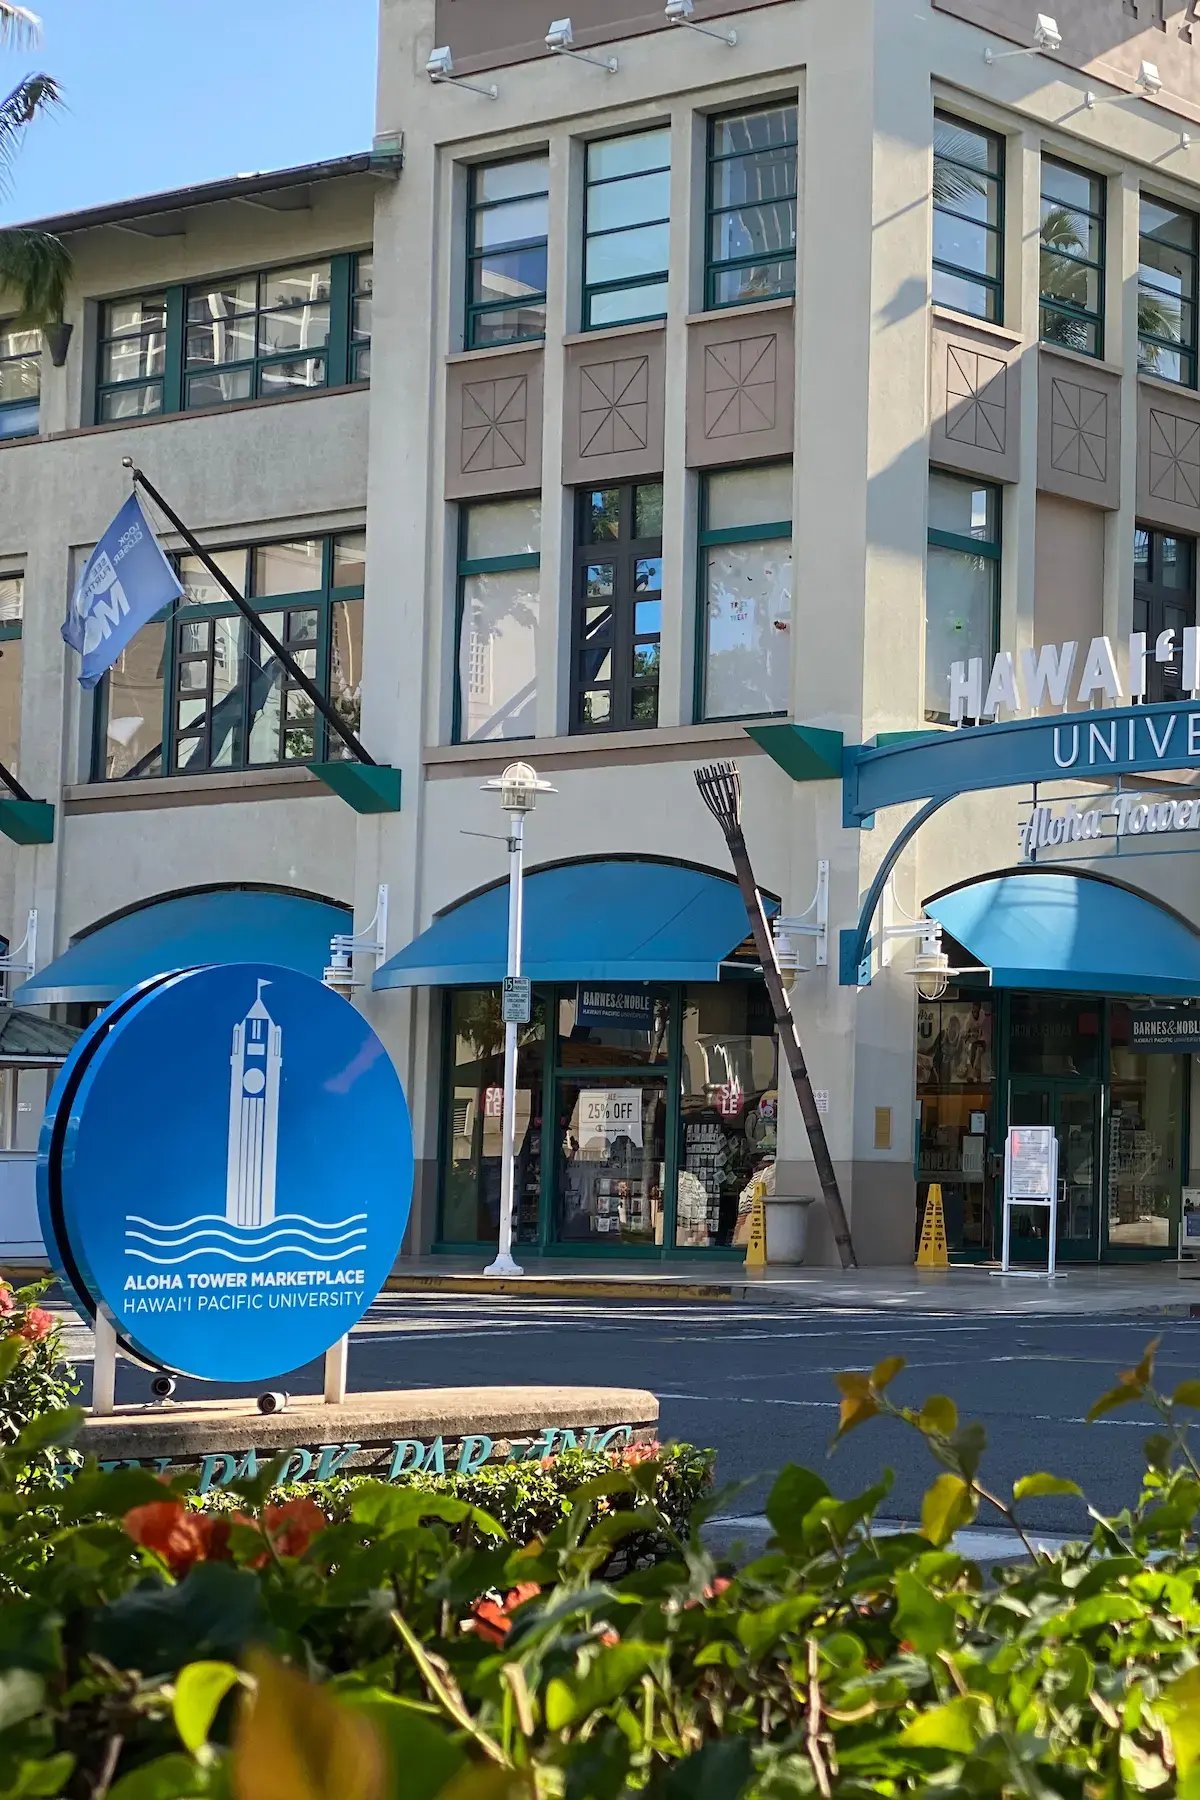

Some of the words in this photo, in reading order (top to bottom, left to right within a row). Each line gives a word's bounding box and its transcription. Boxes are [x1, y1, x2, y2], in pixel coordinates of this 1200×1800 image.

[1018, 806, 1102, 856] Aloha
[505, 978, 513, 990] 15
[583, 991, 650, 1010] BARNES&NOBLE
[917, 1022, 933, 1039] U
[588, 1103, 610, 1119] 25%
[613, 1102, 633, 1119] OFF
[721, 1099, 738, 1114] LE
[123, 1273, 184, 1291] ALOHA
[187, 1271, 247, 1289] TOWER
[251, 1269, 365, 1287] MARKETPLACE
[198, 1293, 263, 1311] PACIFIC
[268, 1291, 365, 1309] UNIVERSITY
